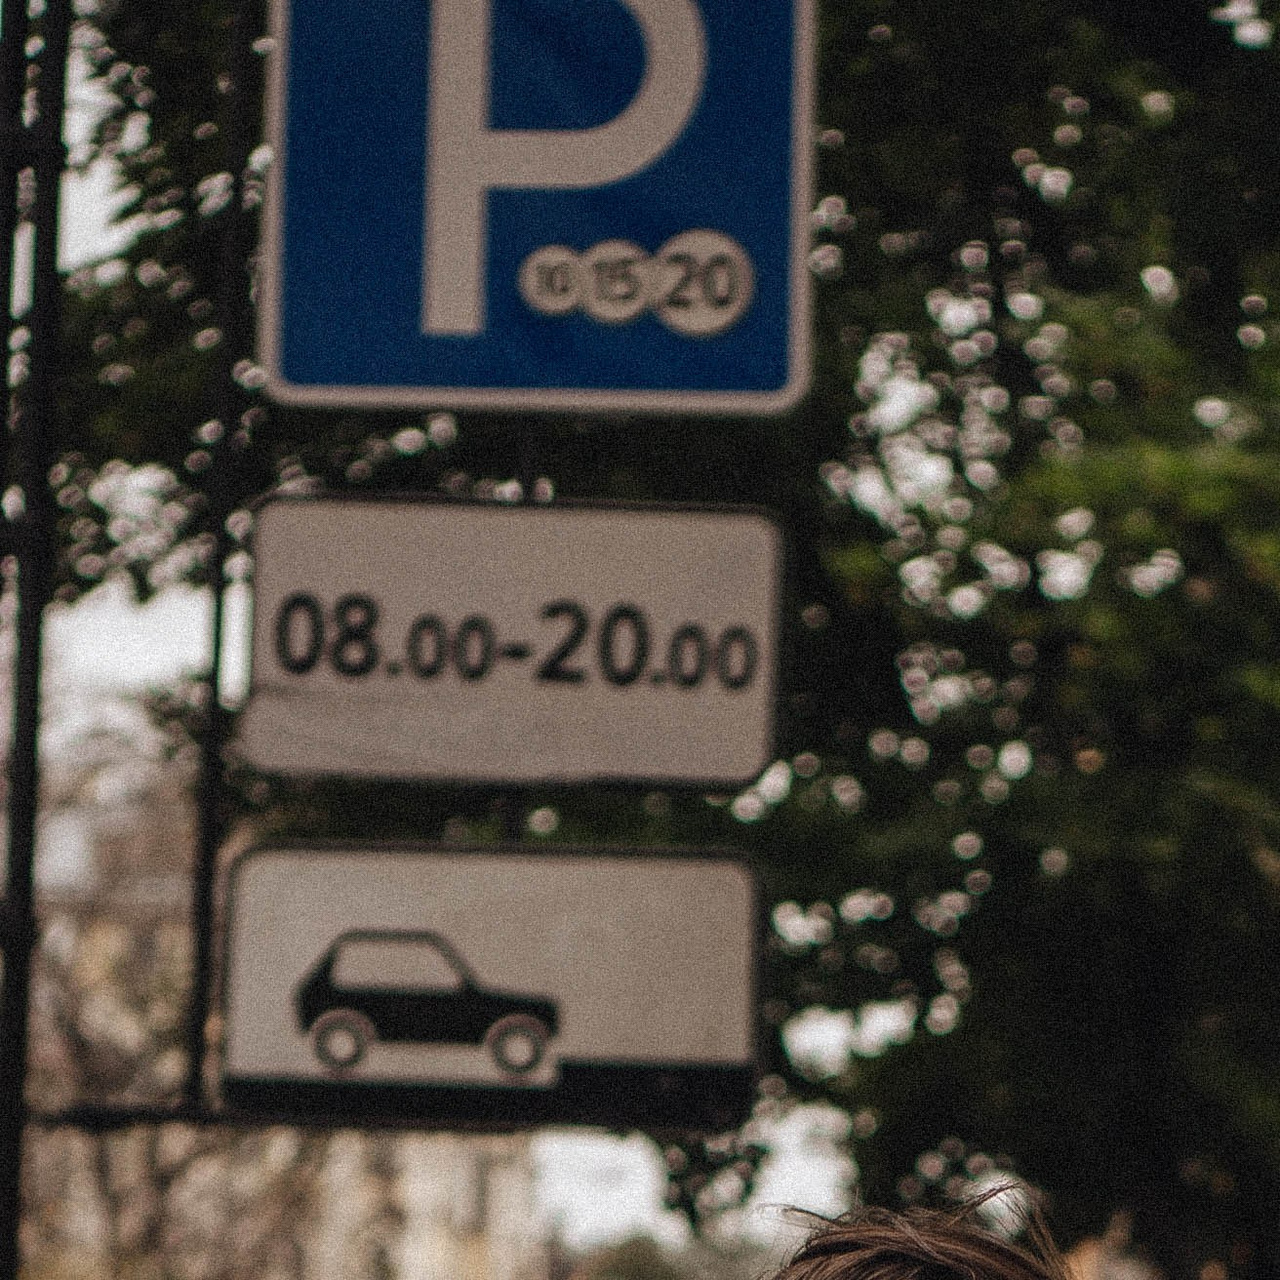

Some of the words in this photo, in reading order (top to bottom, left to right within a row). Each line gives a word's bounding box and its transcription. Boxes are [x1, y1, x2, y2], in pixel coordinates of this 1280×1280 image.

[423, 0, 706, 335] P
[664, 253, 736, 310] 20
[275, 592, 757, 691] 08.00-20.00
